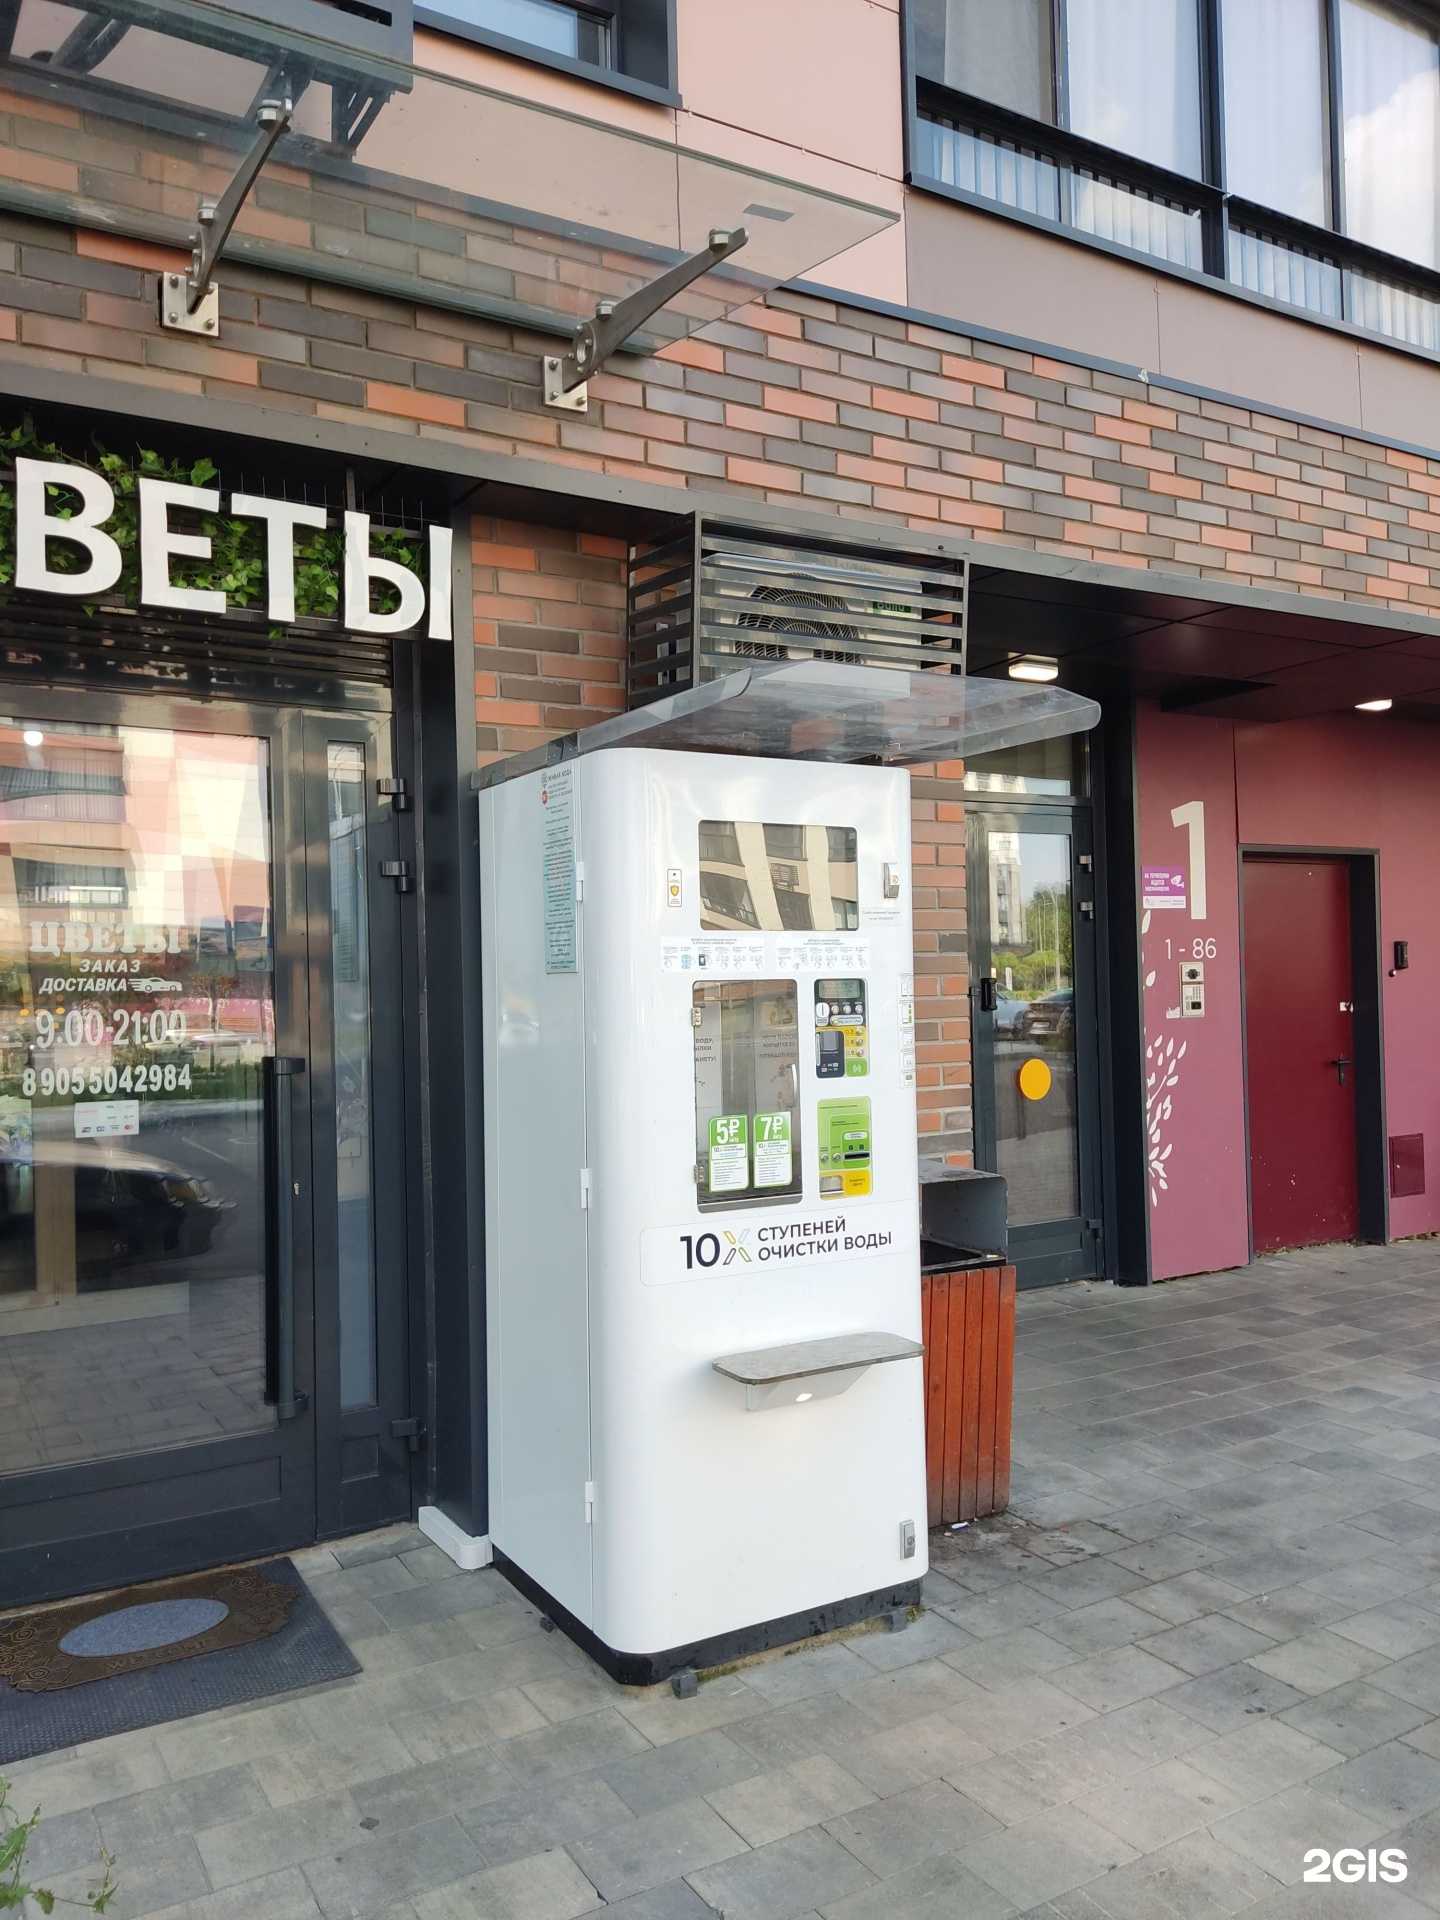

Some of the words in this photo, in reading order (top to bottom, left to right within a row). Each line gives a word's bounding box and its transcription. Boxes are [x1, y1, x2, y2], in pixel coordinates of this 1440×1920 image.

[15, 456, 453, 641] ВЕТЫ
[1171, 801, 1207, 919] 1
[30, 921, 182, 957] ЦВЕТЫ
[1192, 938, 1217, 959] 86
[79, 959, 141, 973] ЗАКАЗ
[39, 977, 128, 995] ДОСТАВКА
[758, 1216, 846, 1242] СТУПЕНЕЙ
[758, 1238, 838, 1261] ОЧИСТКИ
[844, 1231, 893, 1250] ВОДЫ
